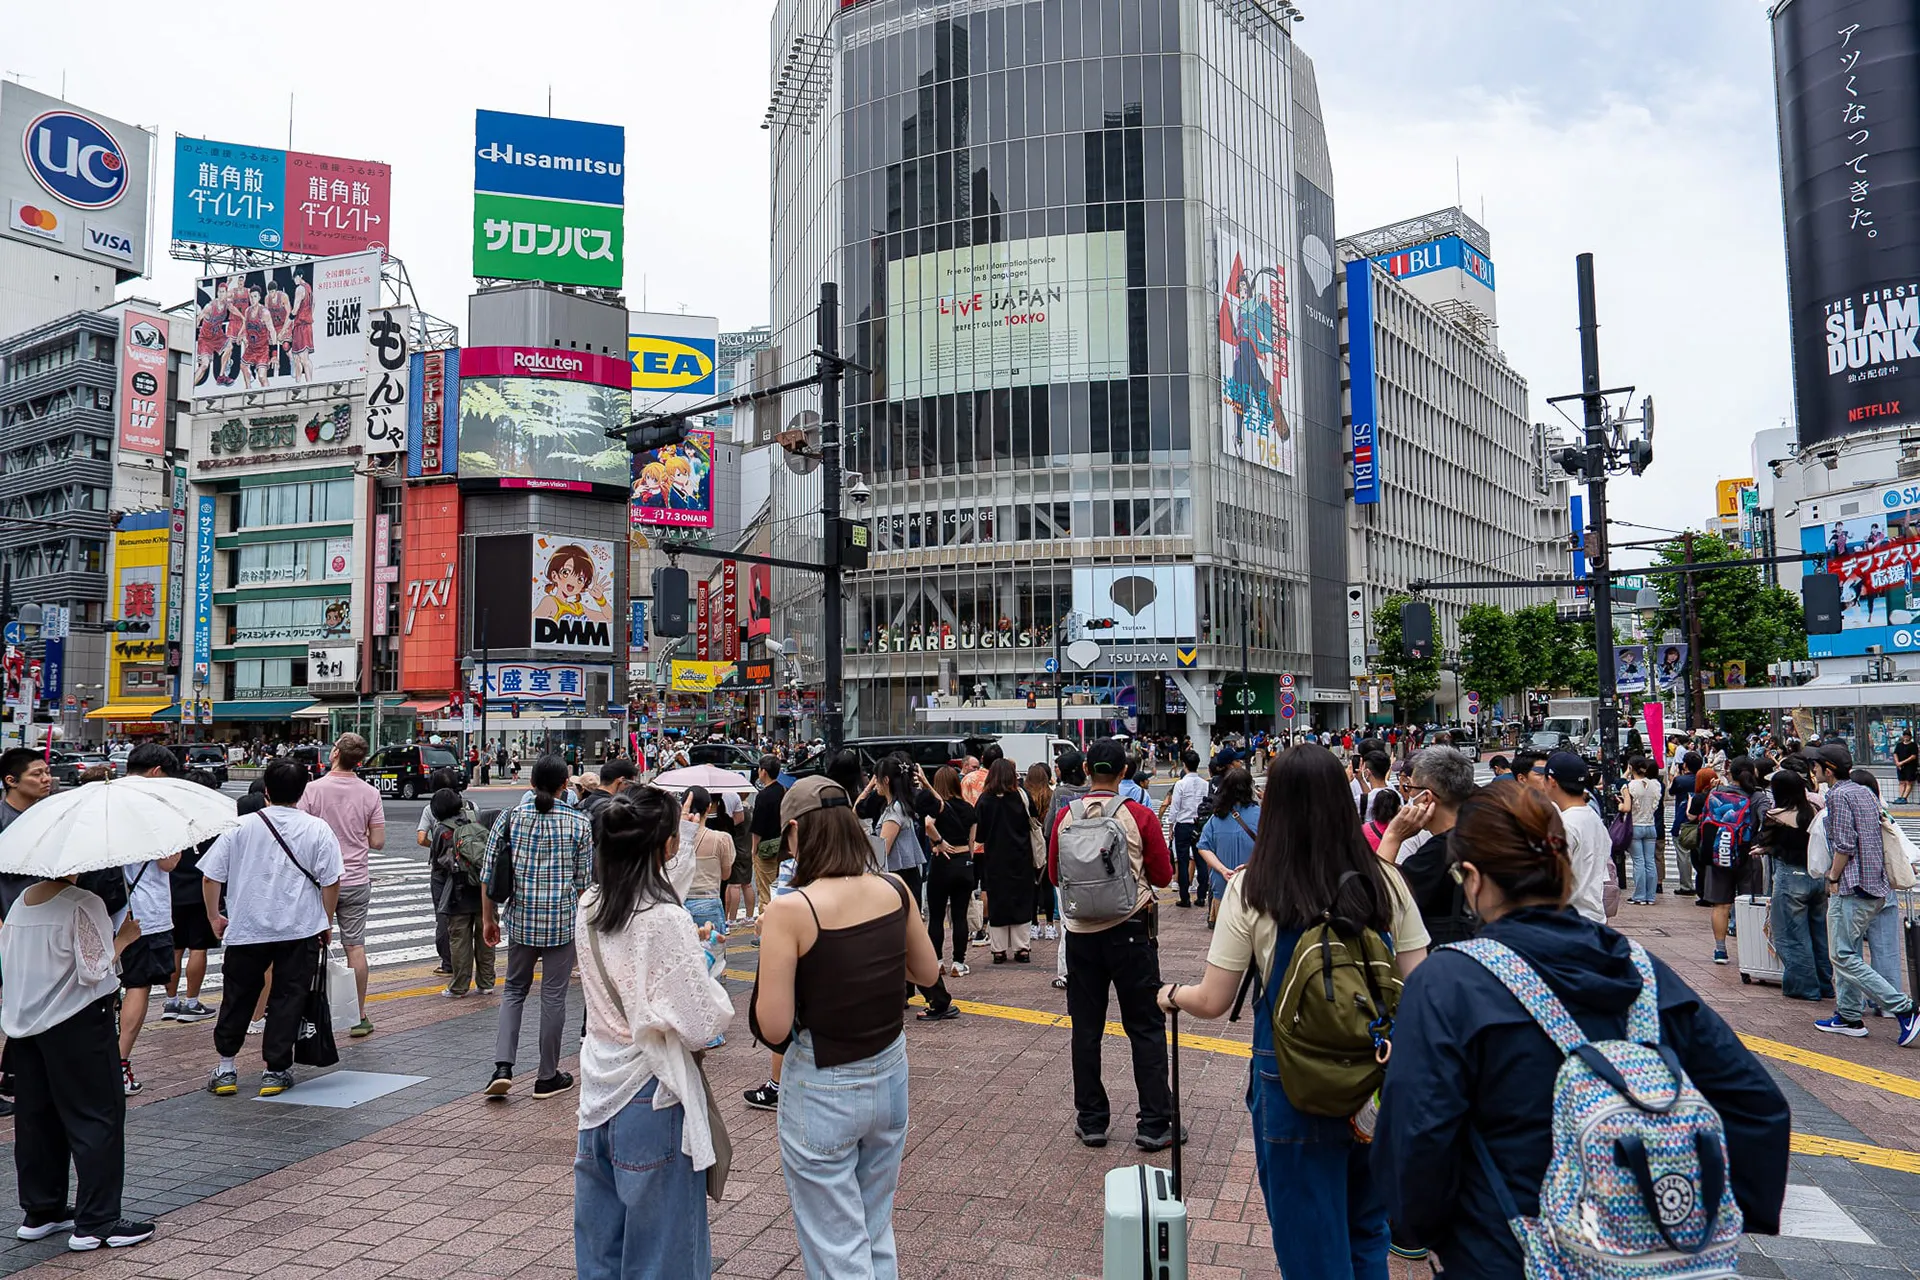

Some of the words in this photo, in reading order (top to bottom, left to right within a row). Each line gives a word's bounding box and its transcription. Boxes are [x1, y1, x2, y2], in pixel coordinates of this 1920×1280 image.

[1838, 24, 1877, 238] アツくなってきた。
[38, 127, 118, 188] UC
[478, 142, 622, 176] Hisamitsu
[199, 162, 264, 193] 龍角散
[309, 176, 370, 206] 龍角散
[87, 228, 132, 254] VISA
[484, 218, 614, 262] サロンパス
[989, 270, 1027, 280] anguages
[1463, 246, 1492, 286] SEIBU
[327, 303, 361, 322] SLAM
[342, 296, 361, 304] FIRST
[991, 286, 1061, 310] JAPAN
[1824, 297, 1852, 316] THE
[1862, 283, 1918, 305] FIRST
[327, 319, 361, 337] DUNK
[1004, 312, 1045, 327] TOKYO
[1305, 304, 1335, 330] TSUTAYA
[1826, 295, 1920, 346] SLAM
[514, 352, 583, 372] Rakuten
[1827, 326, 1920, 376] DUNK
[367, 309, 406, 449] もんじゃ
[1848, 365, 1899, 384] 独占配信中
[423, 354, 441, 469] 三千里薬品
[1848, 400, 1901, 422] NETFLIX
[1353, 422, 1373, 491] SEIBU
[198, 516, 214, 613] サマーフルーツギフト
[125, 582, 155, 618] 薬
[404, 562, 455, 635] クスリ
[724, 564, 735, 617] カラオケ
[237, 628, 322, 640] ジャスミンレディースクリニック
[535, 617, 610, 647] DMM
[698, 622, 708, 660] カラオ
[878, 632, 1031, 652] STARBUCKS
[316, 660, 342, 677] 松川
[1108, 652, 1169, 663] TSUTAYA
[478, 669, 588, 693] 大盛堂書
[1718, 831, 1732, 868] arena
